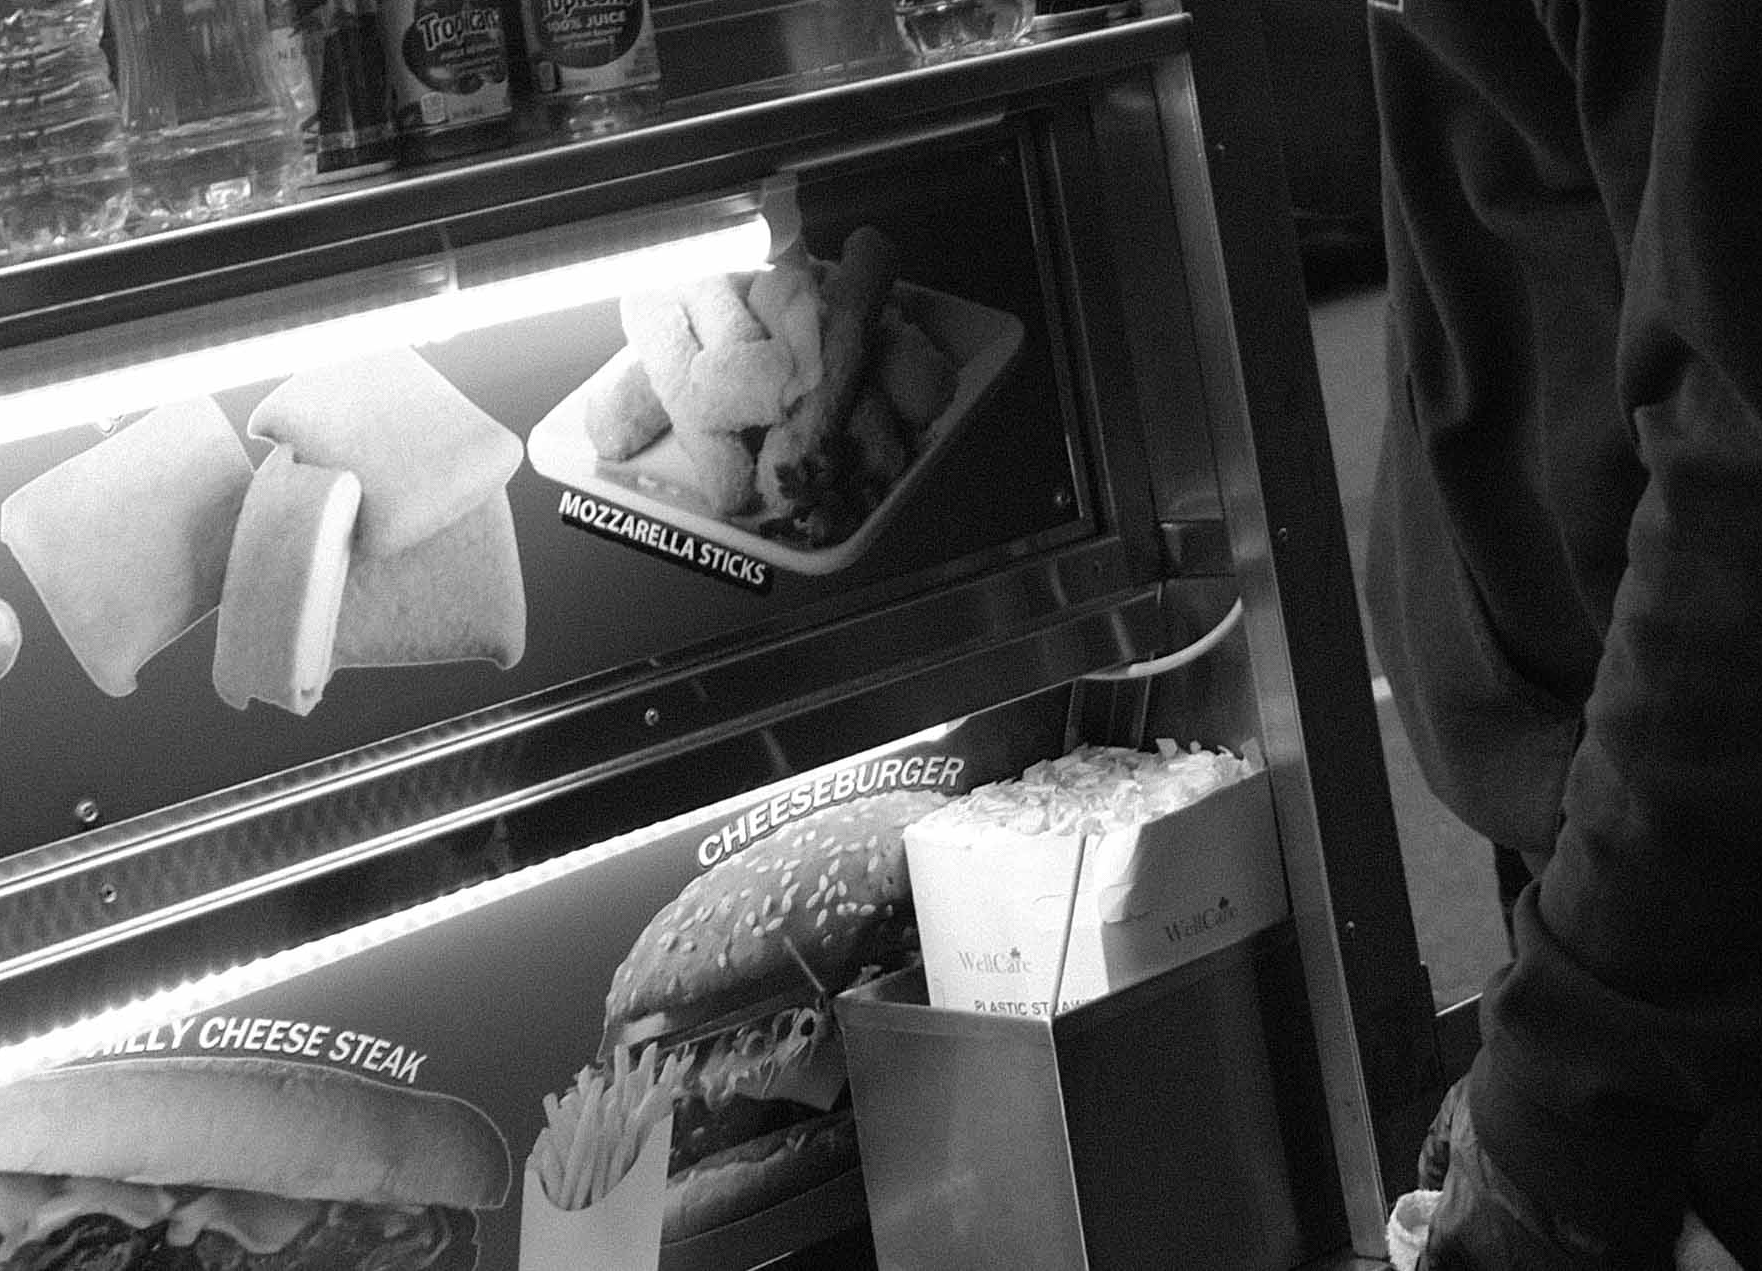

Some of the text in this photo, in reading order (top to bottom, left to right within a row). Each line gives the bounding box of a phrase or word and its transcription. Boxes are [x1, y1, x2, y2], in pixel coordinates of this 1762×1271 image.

[416, 8, 501, 51] Tropican
[587, 10, 627, 27] JUICE
[558, 491, 765, 585] MOZZARELLA STICKS
[697, 756, 965, 867] CHEESEBURGER
[958, 950, 1033, 976] WellCare
[974, 999, 1028, 1016] PLASTIC
[199, 1017, 330, 1056] CHEESE
[329, 1030, 428, 1084] STEAK
